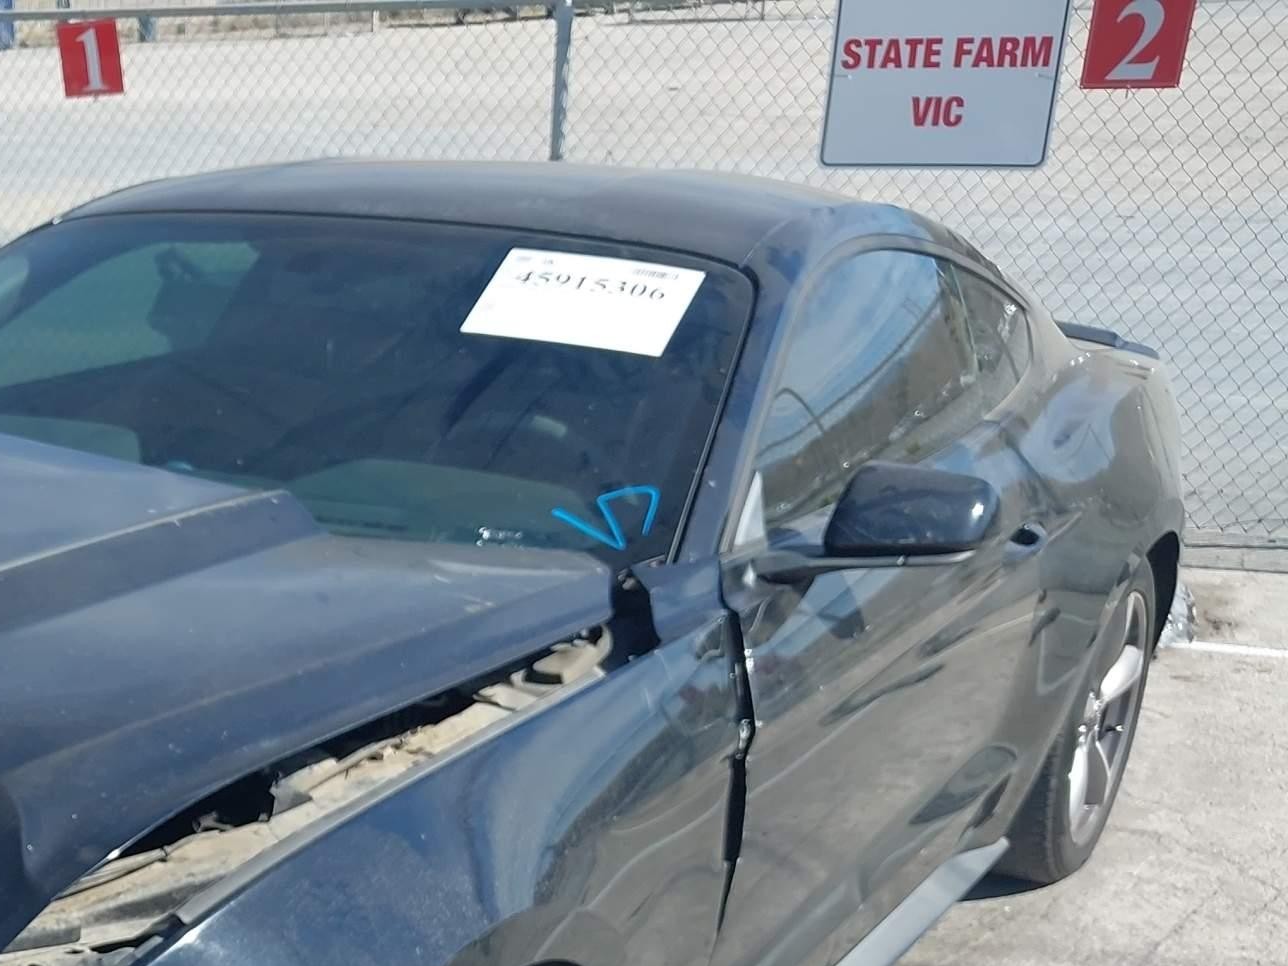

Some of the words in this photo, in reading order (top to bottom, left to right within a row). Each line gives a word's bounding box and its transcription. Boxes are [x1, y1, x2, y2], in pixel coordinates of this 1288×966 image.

[75, 27, 111, 91] 1
[840, 38, 943, 69] STATE
[953, 36, 1053, 68] FARM
[1104, 0, 1166, 81] 2
[912, 96, 964, 127] VIC
